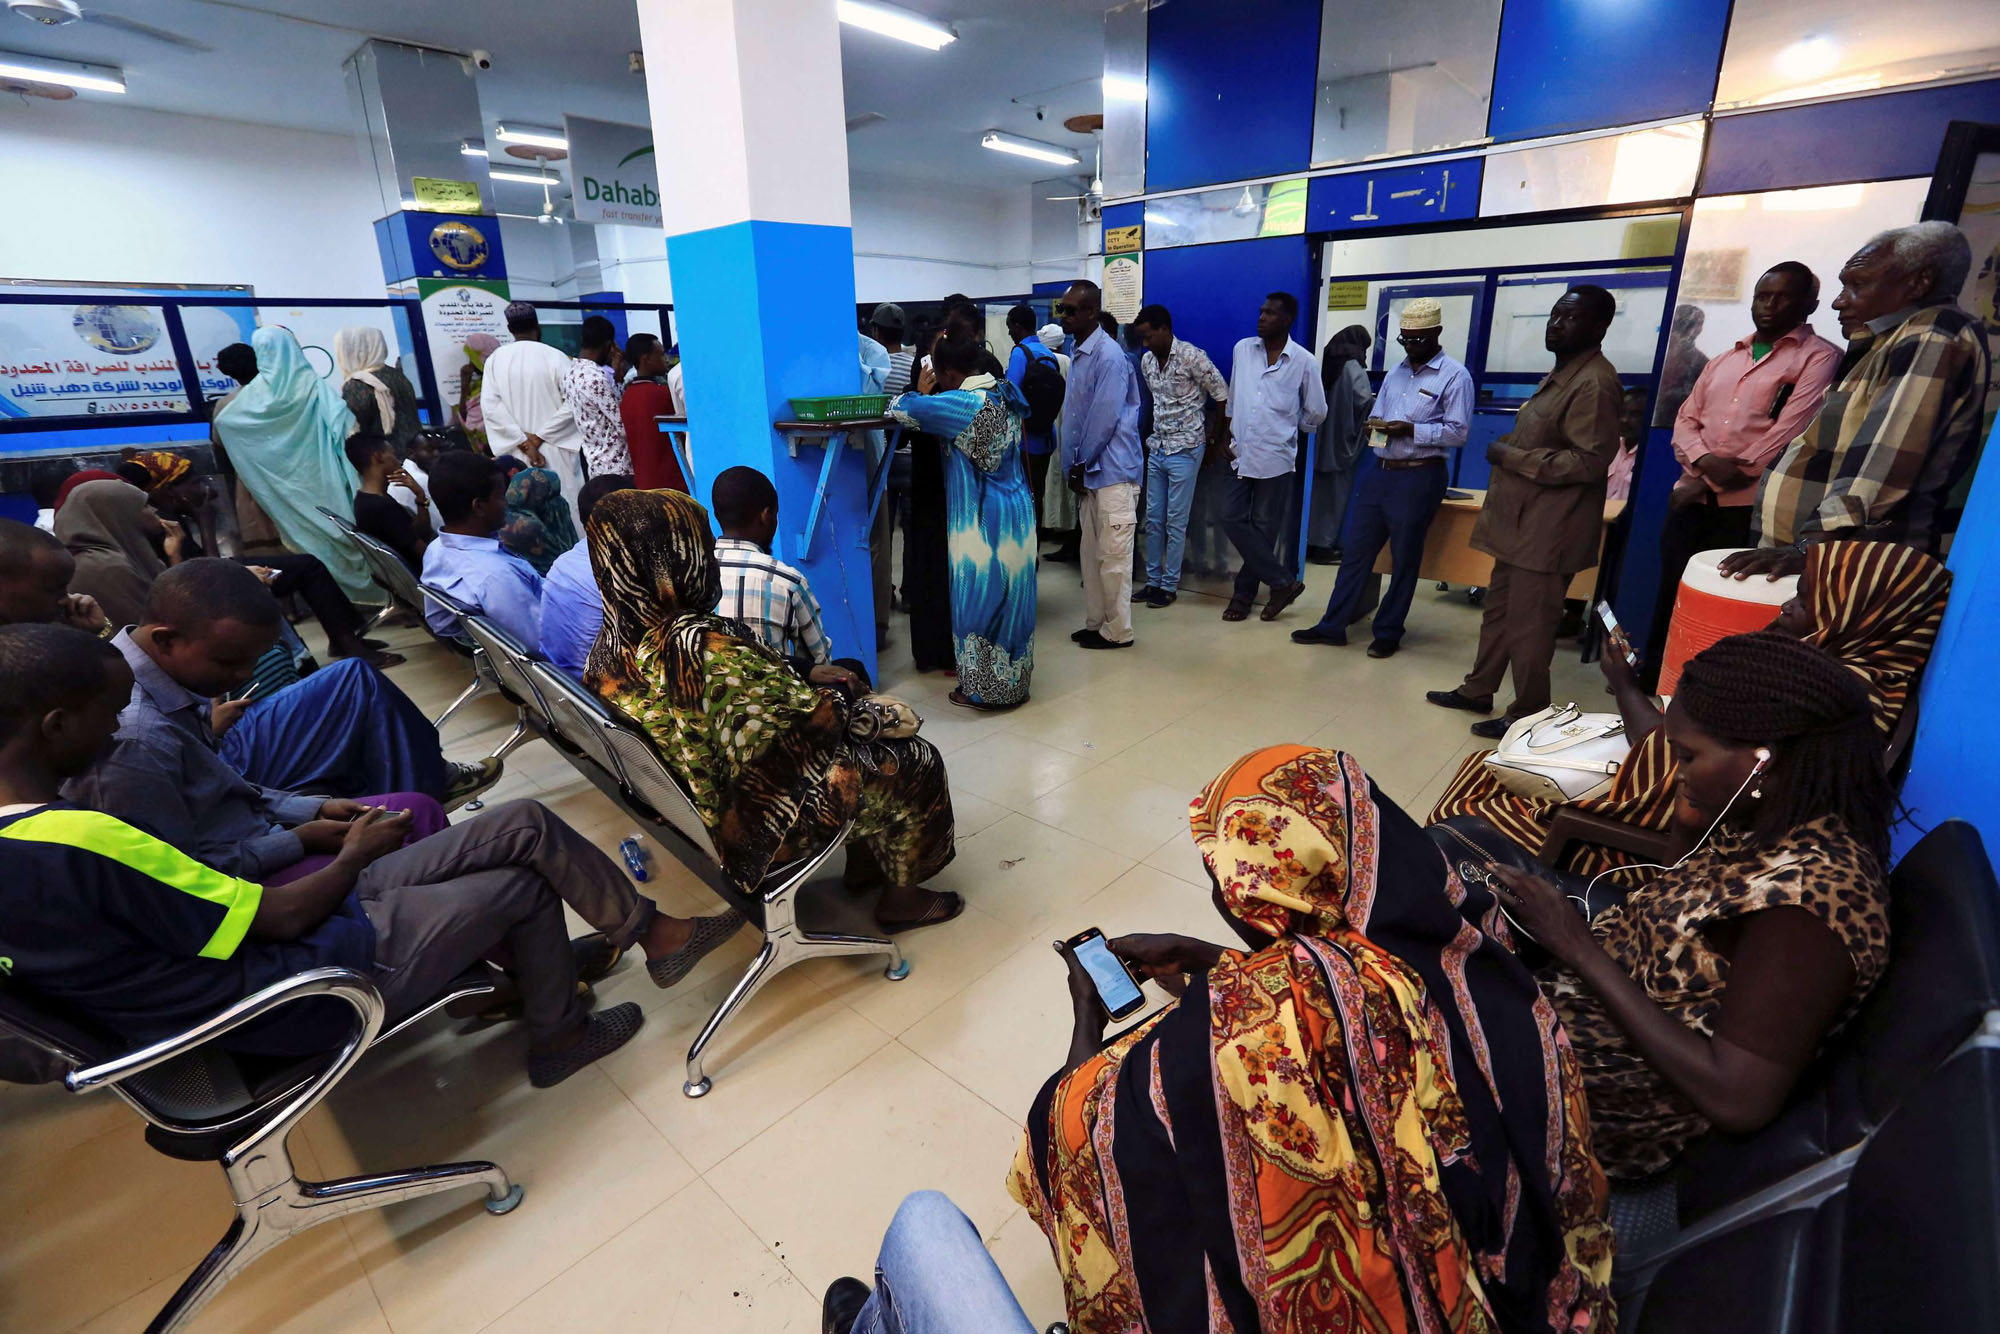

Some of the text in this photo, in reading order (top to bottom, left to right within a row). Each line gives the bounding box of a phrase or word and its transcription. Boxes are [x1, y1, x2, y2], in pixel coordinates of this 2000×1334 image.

[583, 176, 661, 207] Dahab
[0, 362, 60, 377] المحدود
[62, 360, 129, 375] للصرافة
[92, 381, 141, 394] لشركة
[142, 379, 183, 392] لوحيد
[200, 378, 235, 390] الوكي
